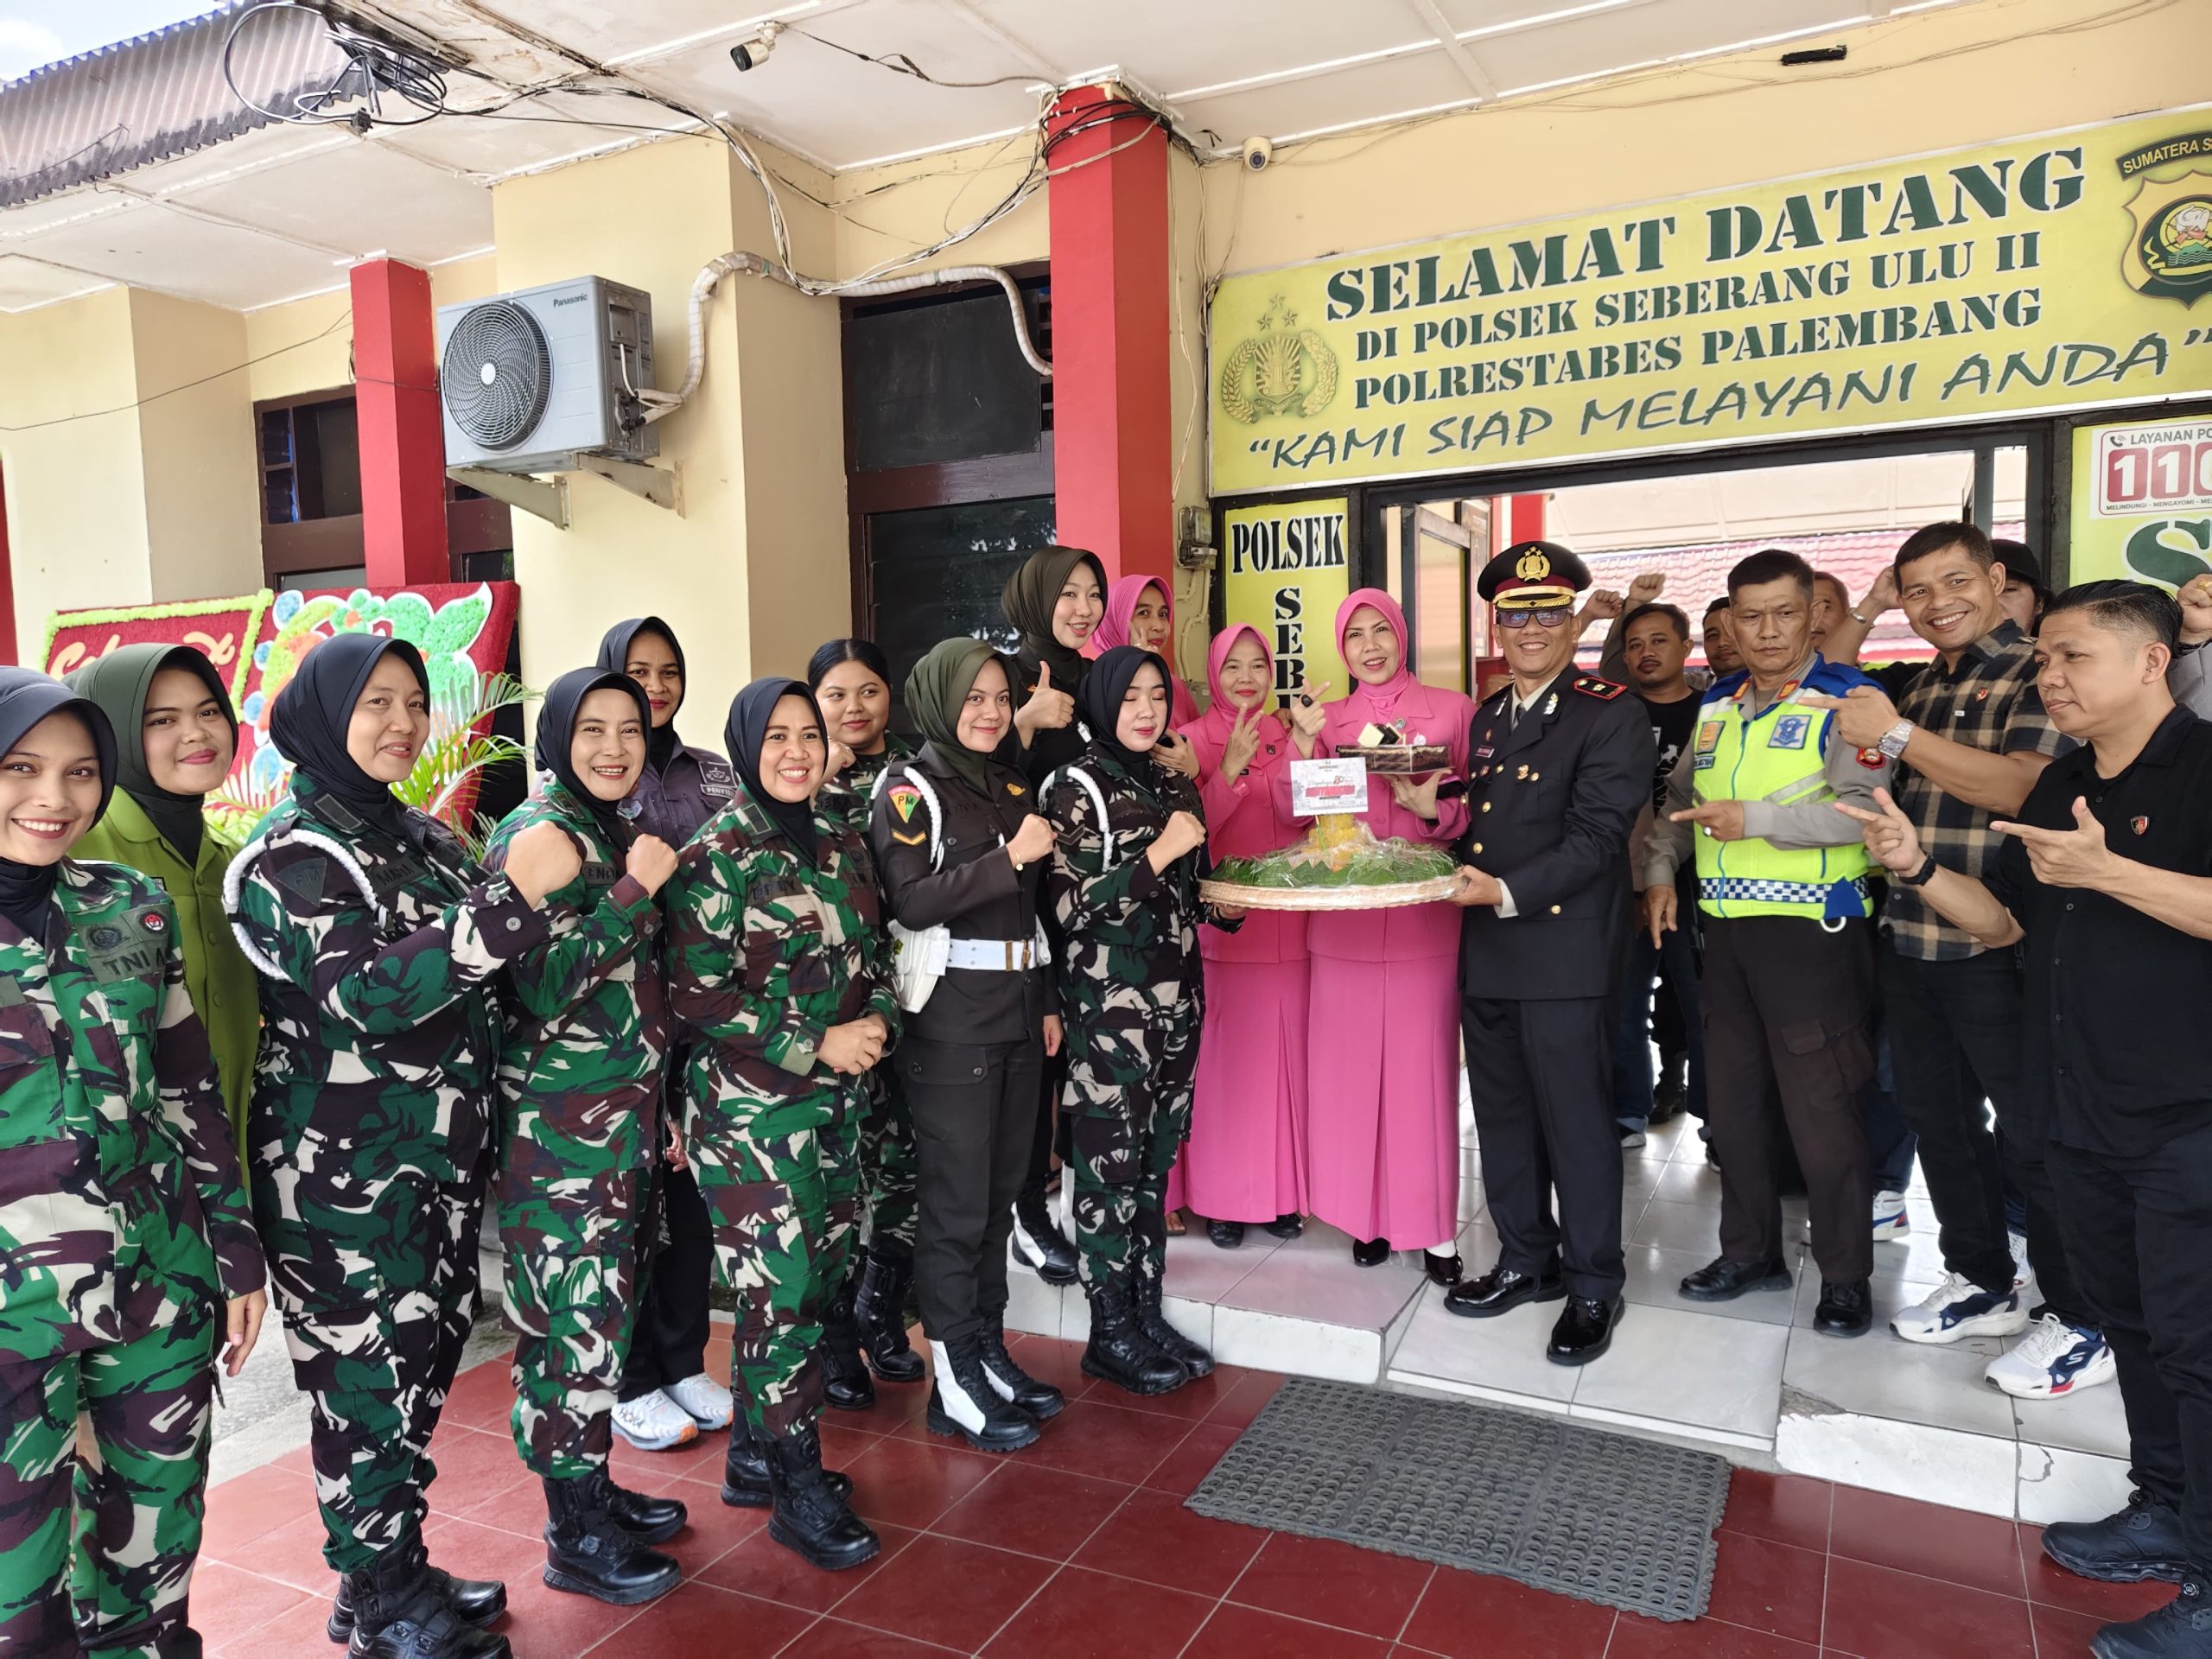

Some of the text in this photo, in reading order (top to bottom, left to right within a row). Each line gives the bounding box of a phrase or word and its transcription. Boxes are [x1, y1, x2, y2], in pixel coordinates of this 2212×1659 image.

[2123, 140, 2199, 174] SUMATERA
[1326, 147, 2084, 321] SELAMAT DATANG
[553, 293, 588, 308] Panasonic
[1356, 232, 2041, 361] DI POLSEK SEBERANG ULU II
[1354, 288, 2041, 410] POLRESTABES PALEMBANG
[1427, 408, 1553, 455] SIAP
[1581, 362, 1917, 435] MELAYANI
[2131, 429, 2193, 445] LAYANAN
[1231, 515, 1345, 573] POLSEK
[899, 795, 913, 805] PM
[102, 950, 151, 976] TNI
